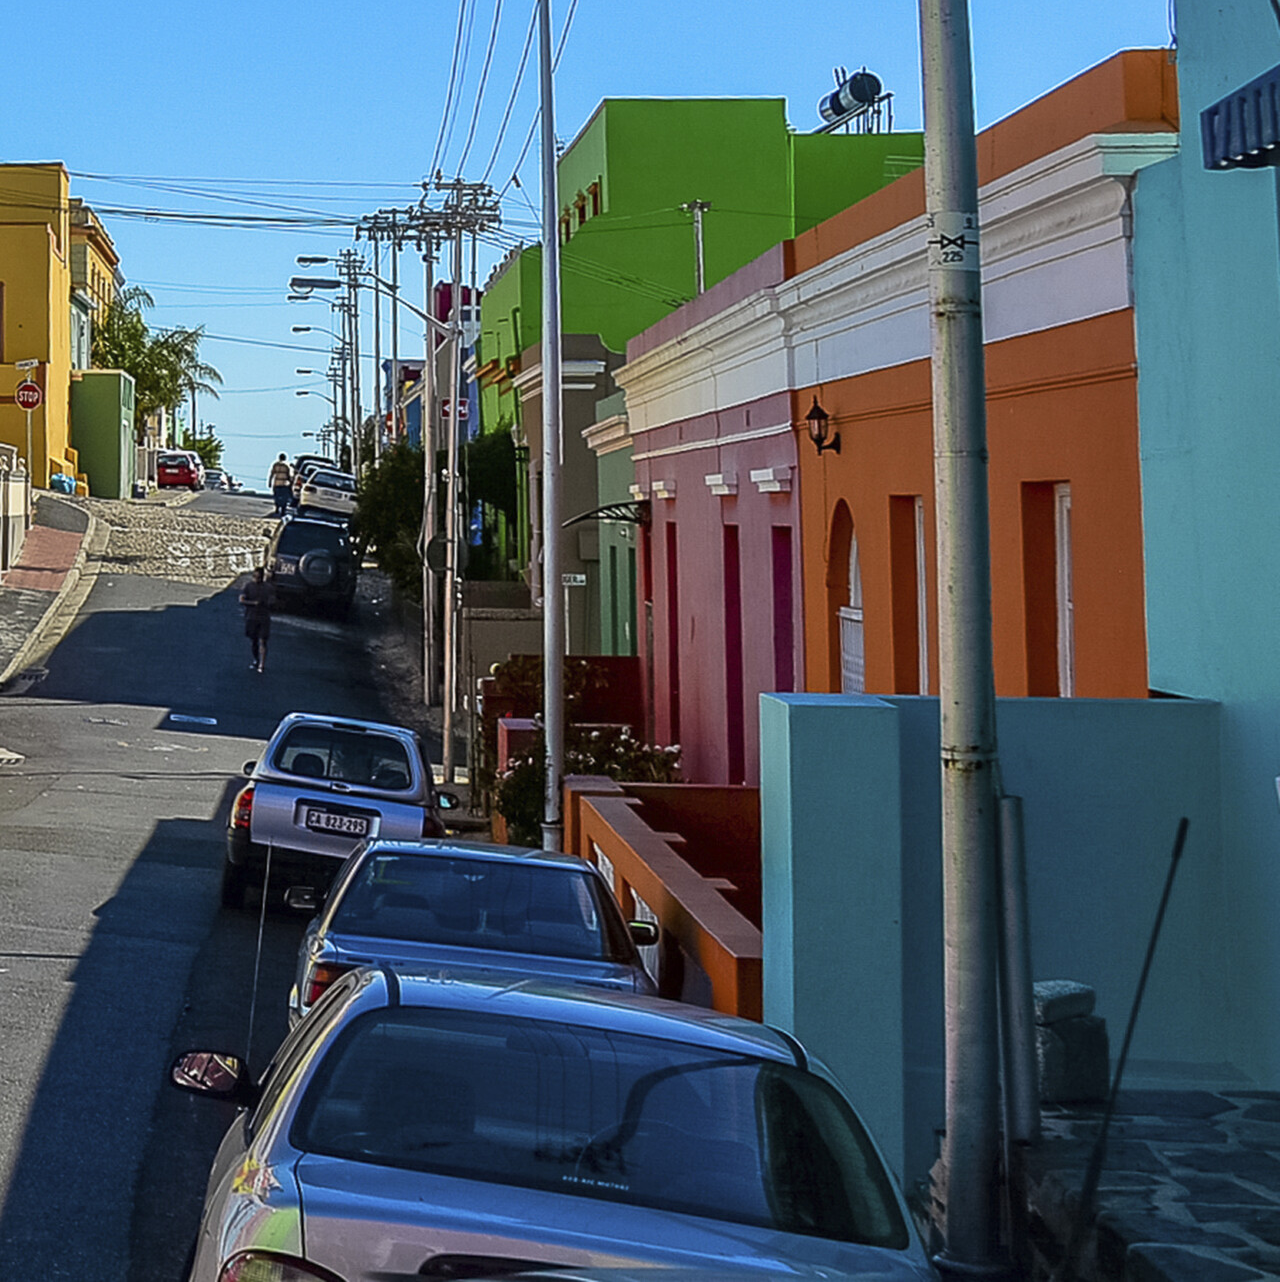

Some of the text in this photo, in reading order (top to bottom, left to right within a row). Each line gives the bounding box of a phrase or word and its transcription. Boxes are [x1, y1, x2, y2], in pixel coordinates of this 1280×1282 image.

[942, 250, 964, 264] 225
[19, 390, 39, 403] STOP
[309, 812, 321, 825] CA
